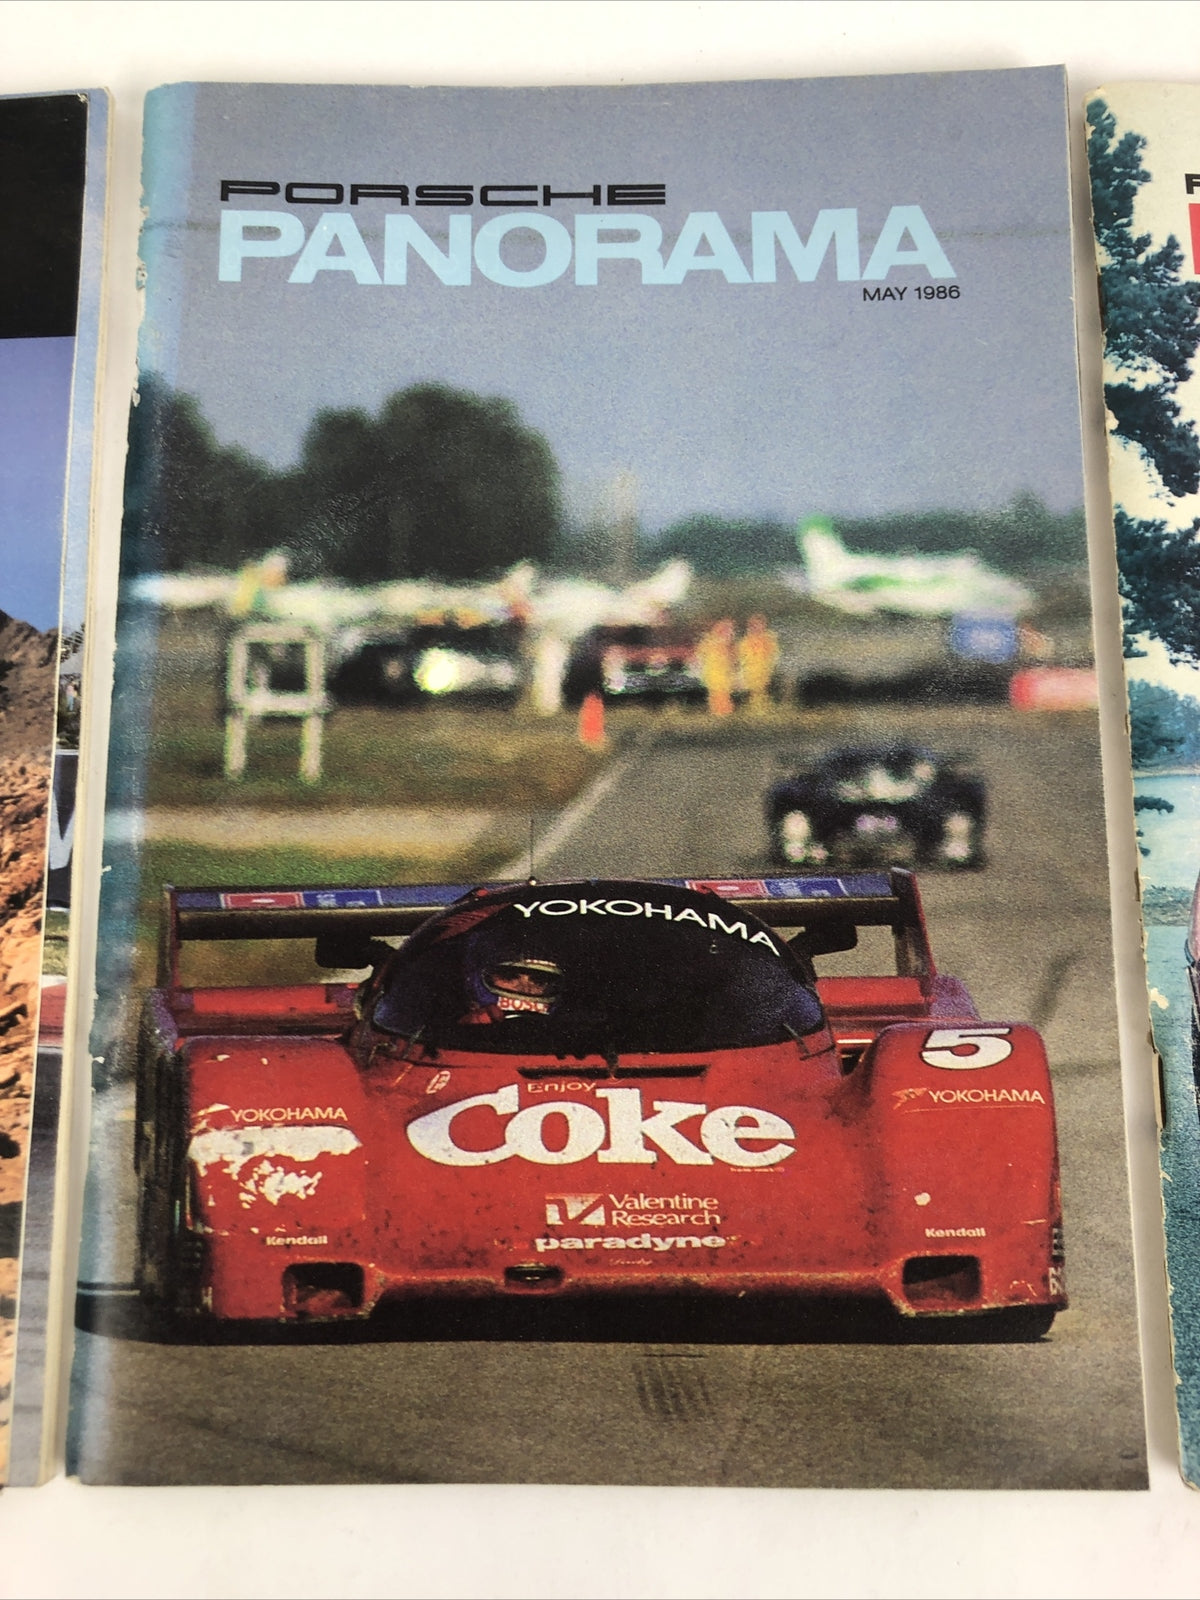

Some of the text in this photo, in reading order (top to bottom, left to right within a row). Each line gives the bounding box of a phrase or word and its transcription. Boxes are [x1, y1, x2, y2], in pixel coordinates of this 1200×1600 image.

[219, 180, 667, 207] PORSCHE
[217, 204, 958, 288] PANORAMA
[862, 284, 961, 302] MAY 1986
[514, 899, 781, 957] YOKOHAMA
[499, 996, 549, 1014] BOSC
[919, 1027, 1013, 1071] 5
[526, 1081, 596, 1094] Enjoy
[928, 1089, 1046, 1105] YOKOHAMA
[231, 1107, 348, 1122] YOKOHAMA
[406, 1084, 796, 1167] Coke
[608, 1192, 719, 1211] Valentine
[611, 1209, 722, 1227] Research
[266, 1235, 328, 1246] Kendall
[925, 1227, 987, 1238] Kendall
[534, 1233, 727, 1252] paradyne
